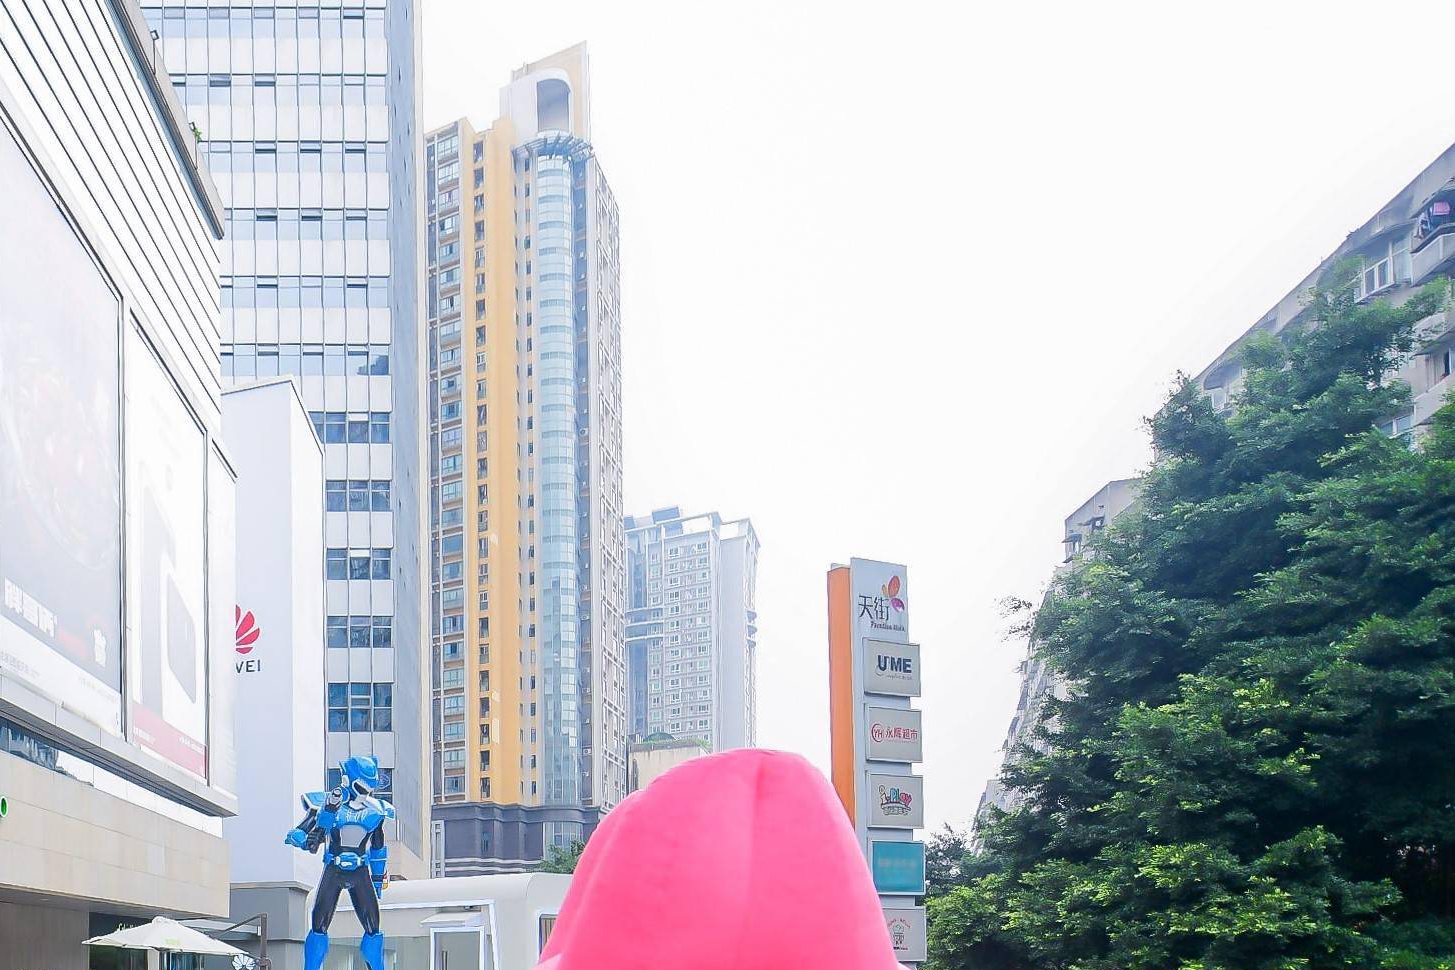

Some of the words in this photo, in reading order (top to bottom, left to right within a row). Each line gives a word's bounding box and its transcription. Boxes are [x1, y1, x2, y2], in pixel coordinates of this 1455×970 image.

[858, 594, 890, 621] 天街
[885, 726, 918, 740] 永辉超市
